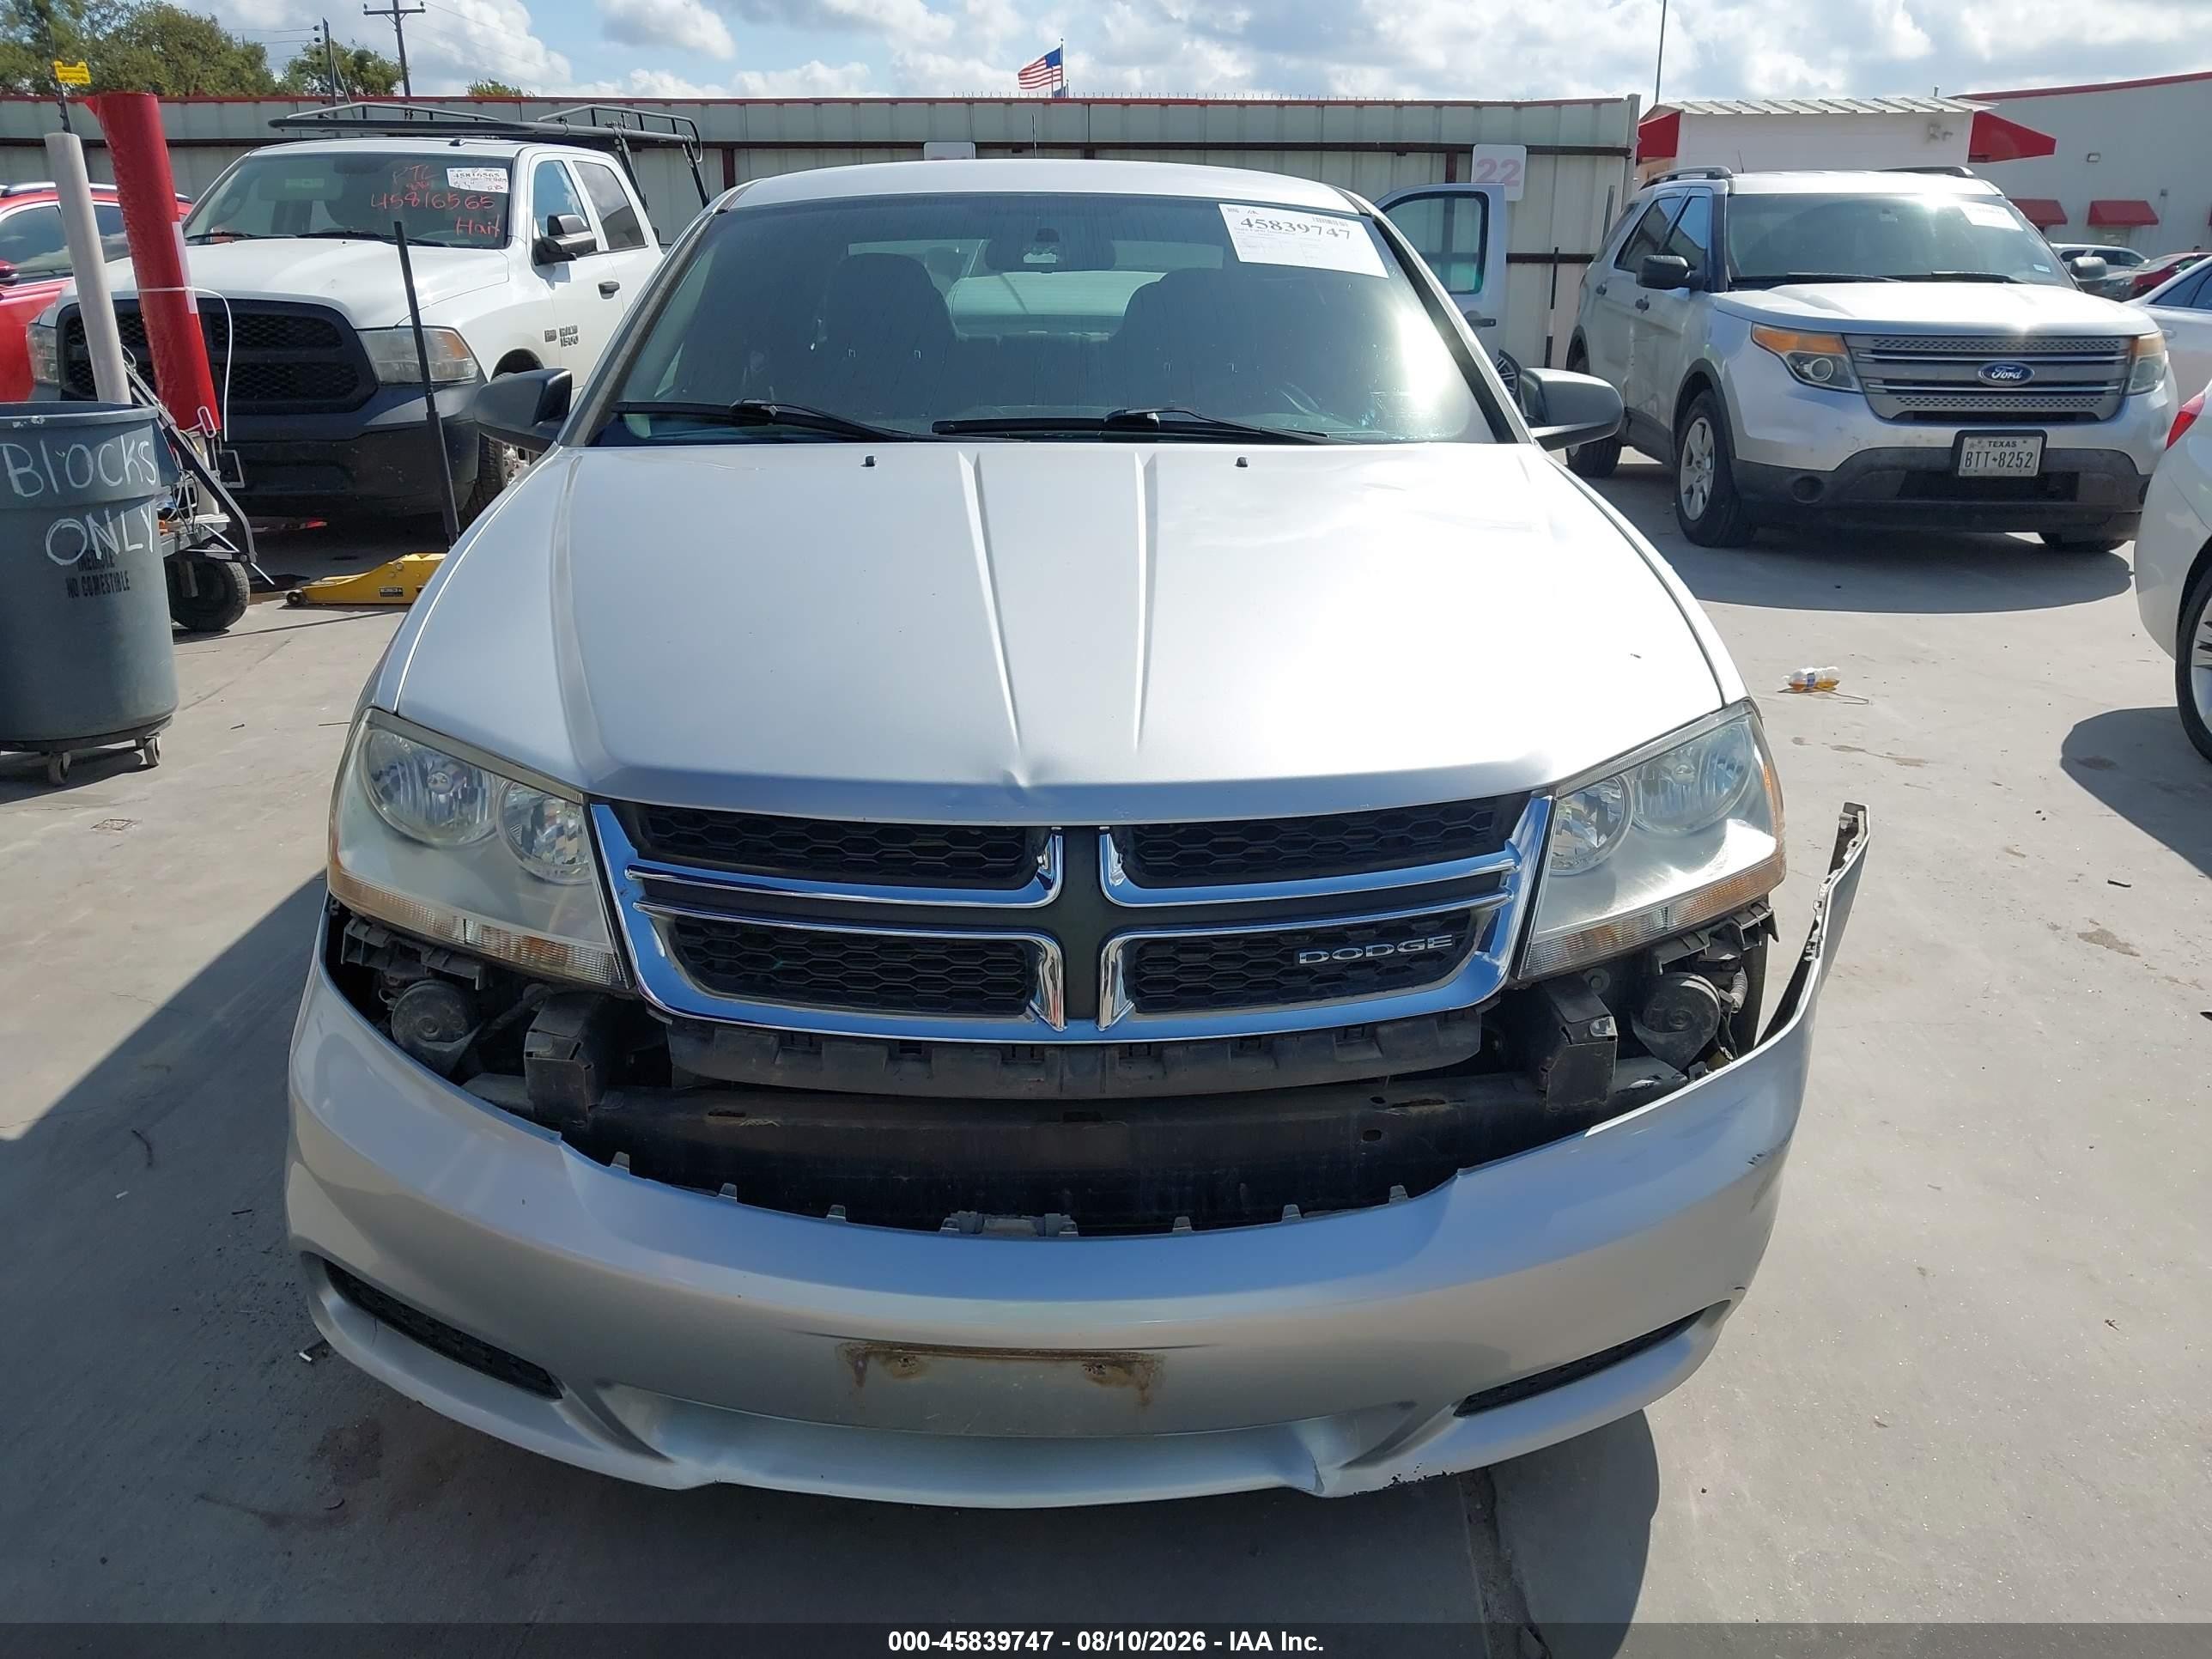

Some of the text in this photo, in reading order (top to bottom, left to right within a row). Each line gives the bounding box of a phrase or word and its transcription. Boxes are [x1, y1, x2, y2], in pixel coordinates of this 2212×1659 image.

[1476, 158, 1521, 186] 22
[371, 191, 495, 210] 45816565
[1240, 217, 1351, 240] 45839747
[1991, 365, 2024, 380] Ford
[46, 503, 154, 566] ONLY
[65, 569, 131, 599] NO COMESTIBLE
[1298, 934, 1453, 964] DODGE
